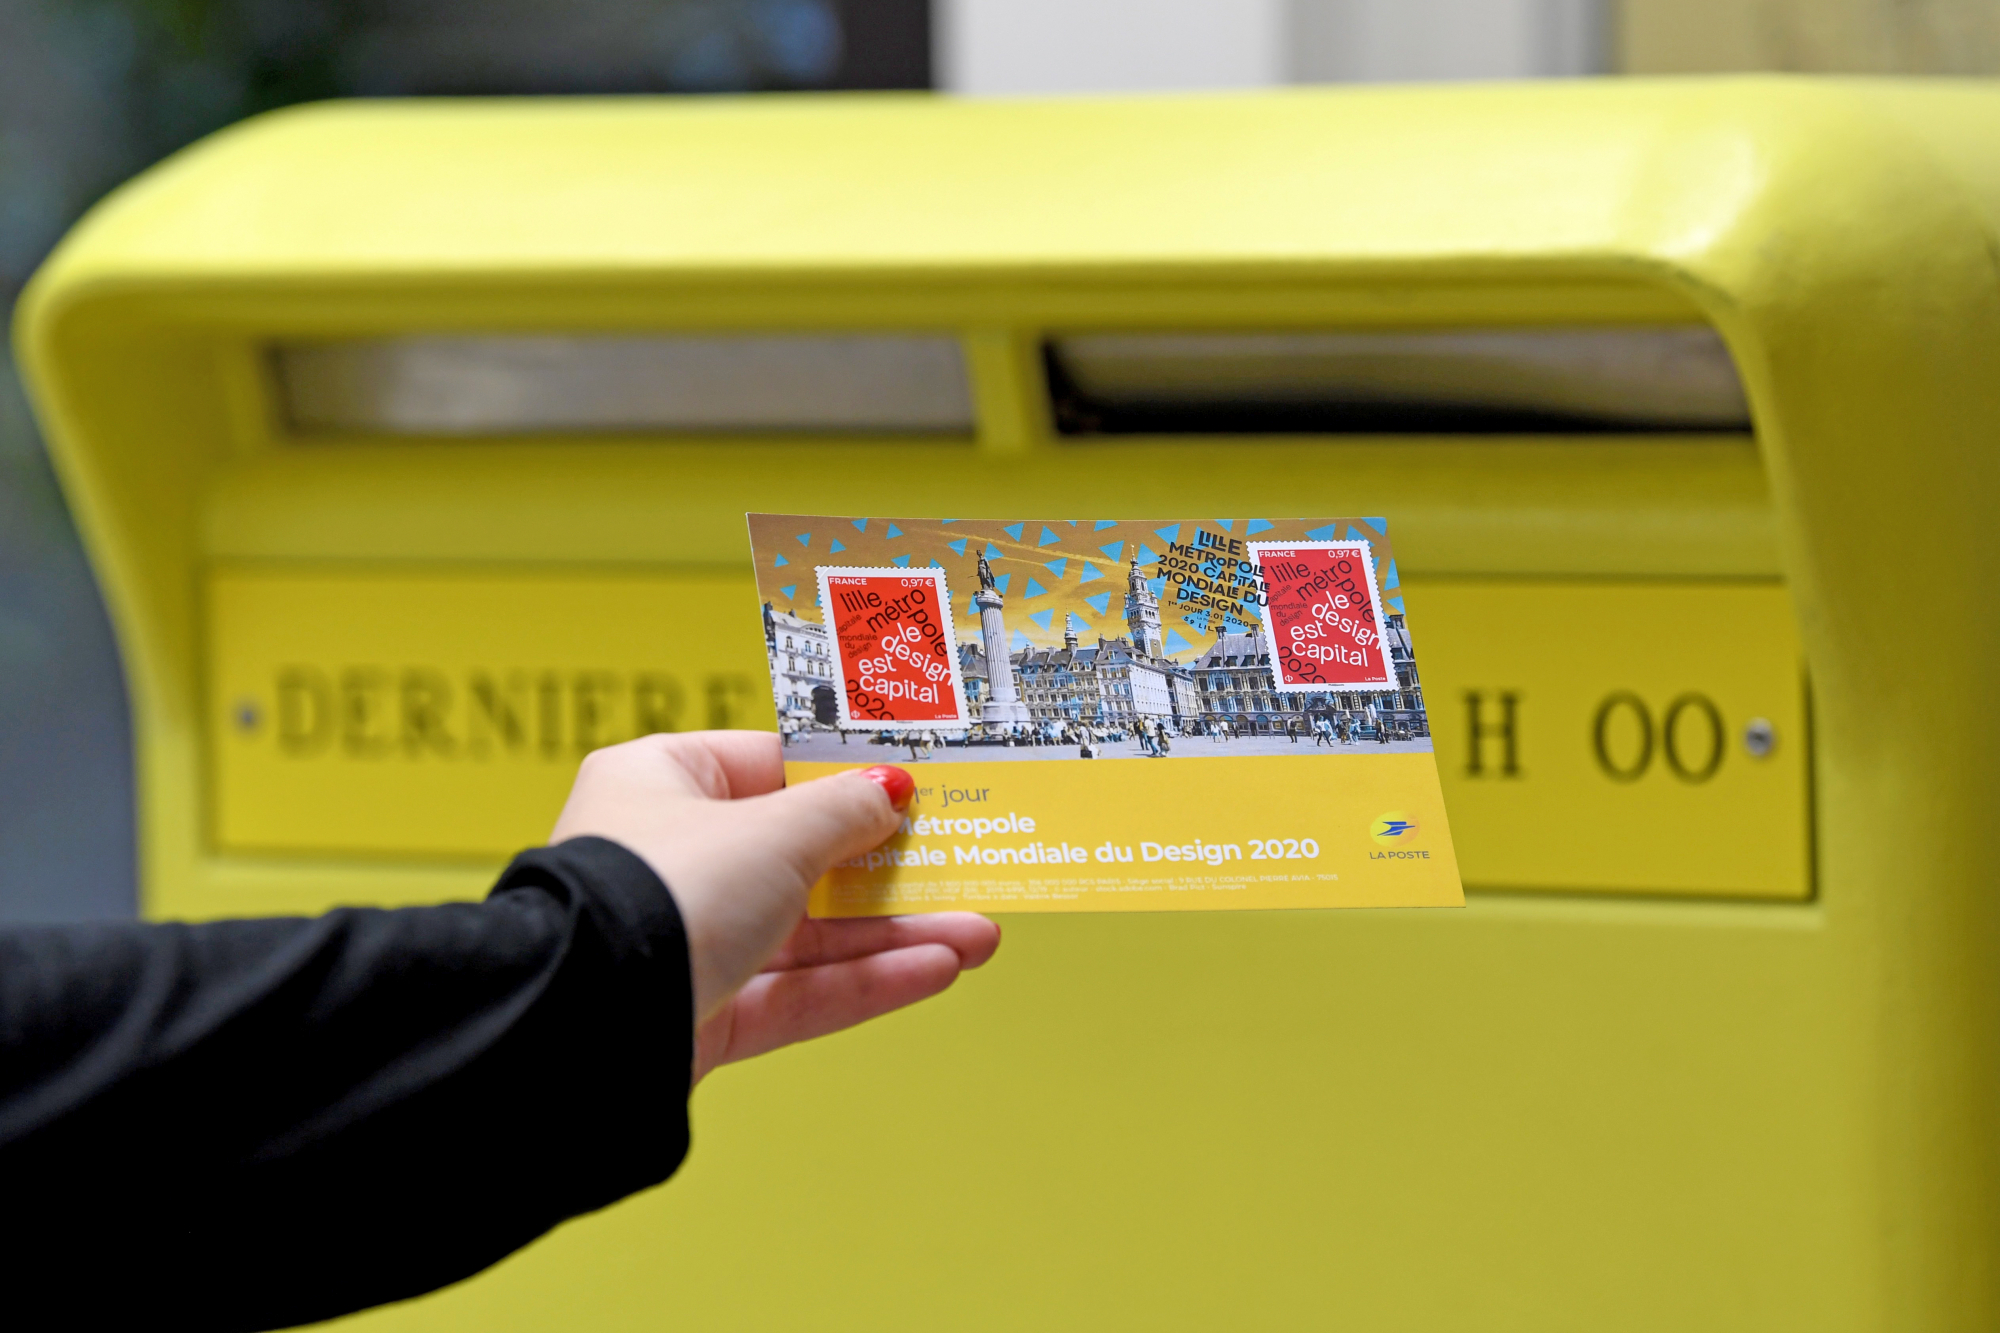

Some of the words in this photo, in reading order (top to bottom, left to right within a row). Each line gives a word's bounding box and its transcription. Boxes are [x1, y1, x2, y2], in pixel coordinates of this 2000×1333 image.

[1198, 530, 1242, 556] LILLE
[1328, 550, 1350, 559] 0,97
[1352, 550, 1360, 558] €
[1169, 542, 1266, 578] MÉTROPOLE
[1270, 562, 1311, 583] lille
[829, 578, 867, 586] FRANCE
[901, 579, 923, 588] 0,97
[925, 579, 934, 587] €
[1158, 554, 1199, 574] 2020
[1204, 566, 1270, 593] CAPITALE
[1296, 560, 1352, 601] métro
[1157, 567, 1239, 599] MONDIALE
[1244, 590, 1269, 607] DU
[840, 590, 882, 612] lille
[866, 589, 926, 633] métro
[1176, 588, 1244, 616] DESIGN
[1271, 602, 1308, 611] mondiale
[1326, 591, 1350, 610] le
[1335, 578, 1375, 623] pole
[1179, 602, 1203, 615] JOUR
[1206, 611, 1249, 627] 3.01.2020
[1276, 610, 1286, 618] du
[1279, 610, 1303, 627] design
[1311, 603, 1381, 650] design
[840, 634, 878, 642] mondiale
[897, 622, 921, 642] le
[907, 608, 947, 657] pole
[1290, 620, 1327, 641] est
[845, 641, 855, 650] du
[848, 641, 872, 658] design
[1292, 641, 1368, 667] capital
[858, 653, 896, 675] est
[881, 635, 953, 686] design
[1279, 646, 1326, 684] 2020
[846, 679, 894, 720] 2020
[860, 675, 939, 704] capital
[1463, 686, 1524, 779] H
[941, 784, 990, 807] jour
[836, 845, 947, 872] apitale
[953, 842, 1088, 865] Mondiale
[1095, 841, 1134, 863] du
[1140, 839, 1242, 866] Design
[1248, 838, 1320, 860] 2020
[1388, 851, 1430, 859] POSTE
